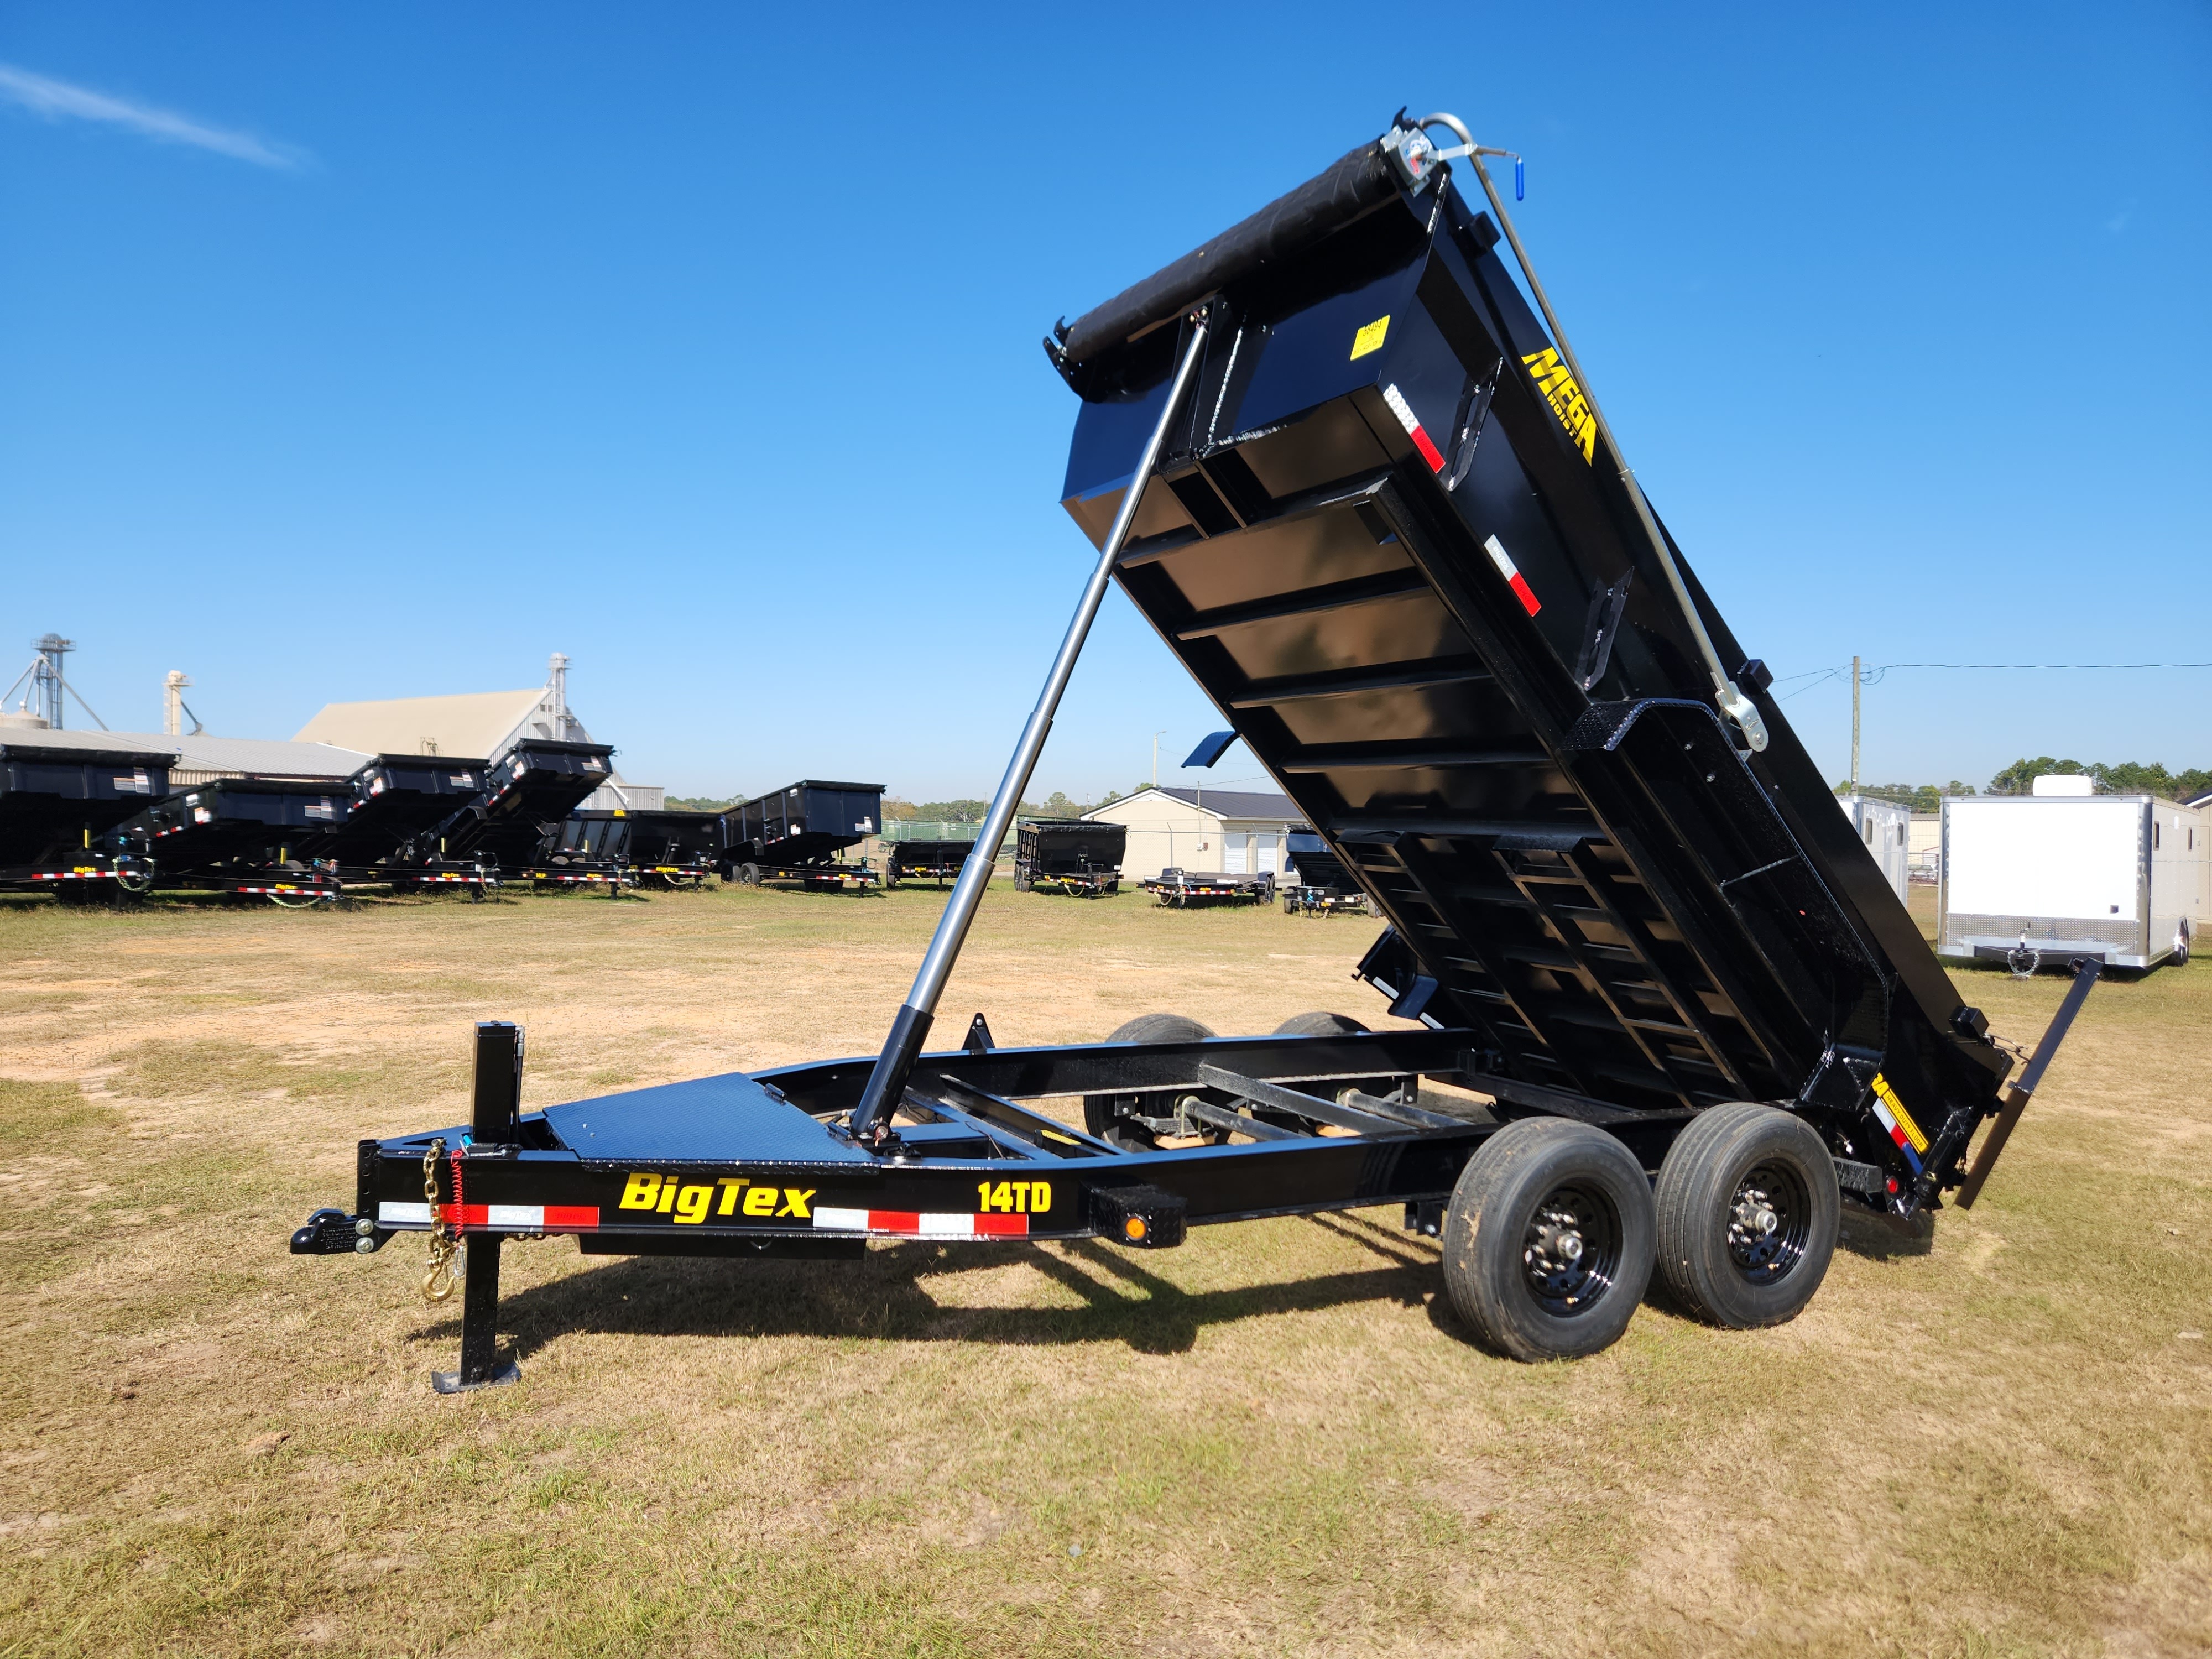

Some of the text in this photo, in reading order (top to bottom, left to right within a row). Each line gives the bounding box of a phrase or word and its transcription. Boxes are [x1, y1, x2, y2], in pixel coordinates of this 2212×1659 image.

[1521, 347, 1597, 467] MEGA
[1547, 393, 1577, 436] HOIST
[1886, 1095, 1923, 1148] HEAVY DUTY FLOOR
[619, 1172, 816, 1224] BigTex
[978, 1182, 1051, 1213] 14TD
